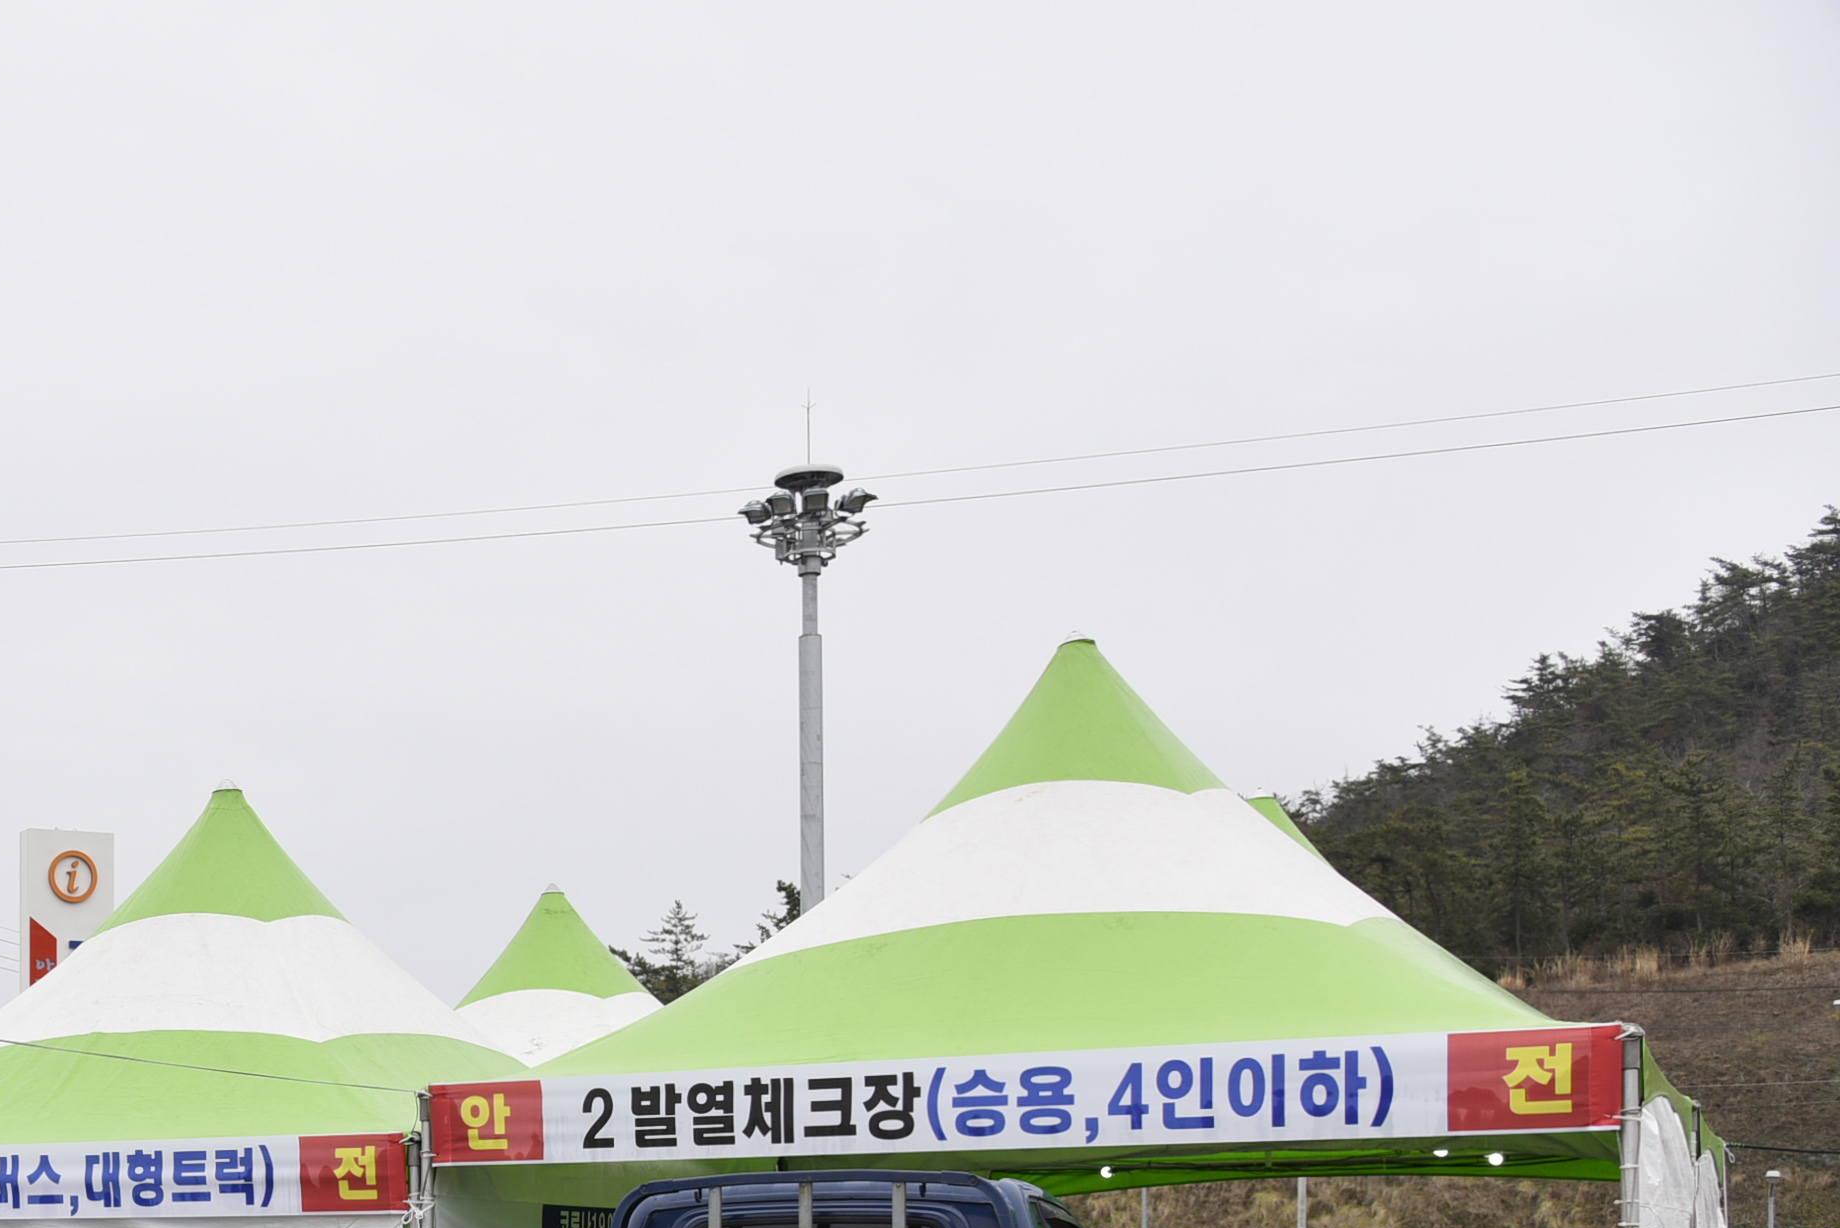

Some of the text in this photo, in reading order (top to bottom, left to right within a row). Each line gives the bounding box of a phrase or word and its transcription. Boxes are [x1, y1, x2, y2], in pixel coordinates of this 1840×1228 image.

[460, 1042, 1573, 1151] 안 2 발열체크장(승용,4인이하) 전
[333, 1145, 379, 1201] 전
